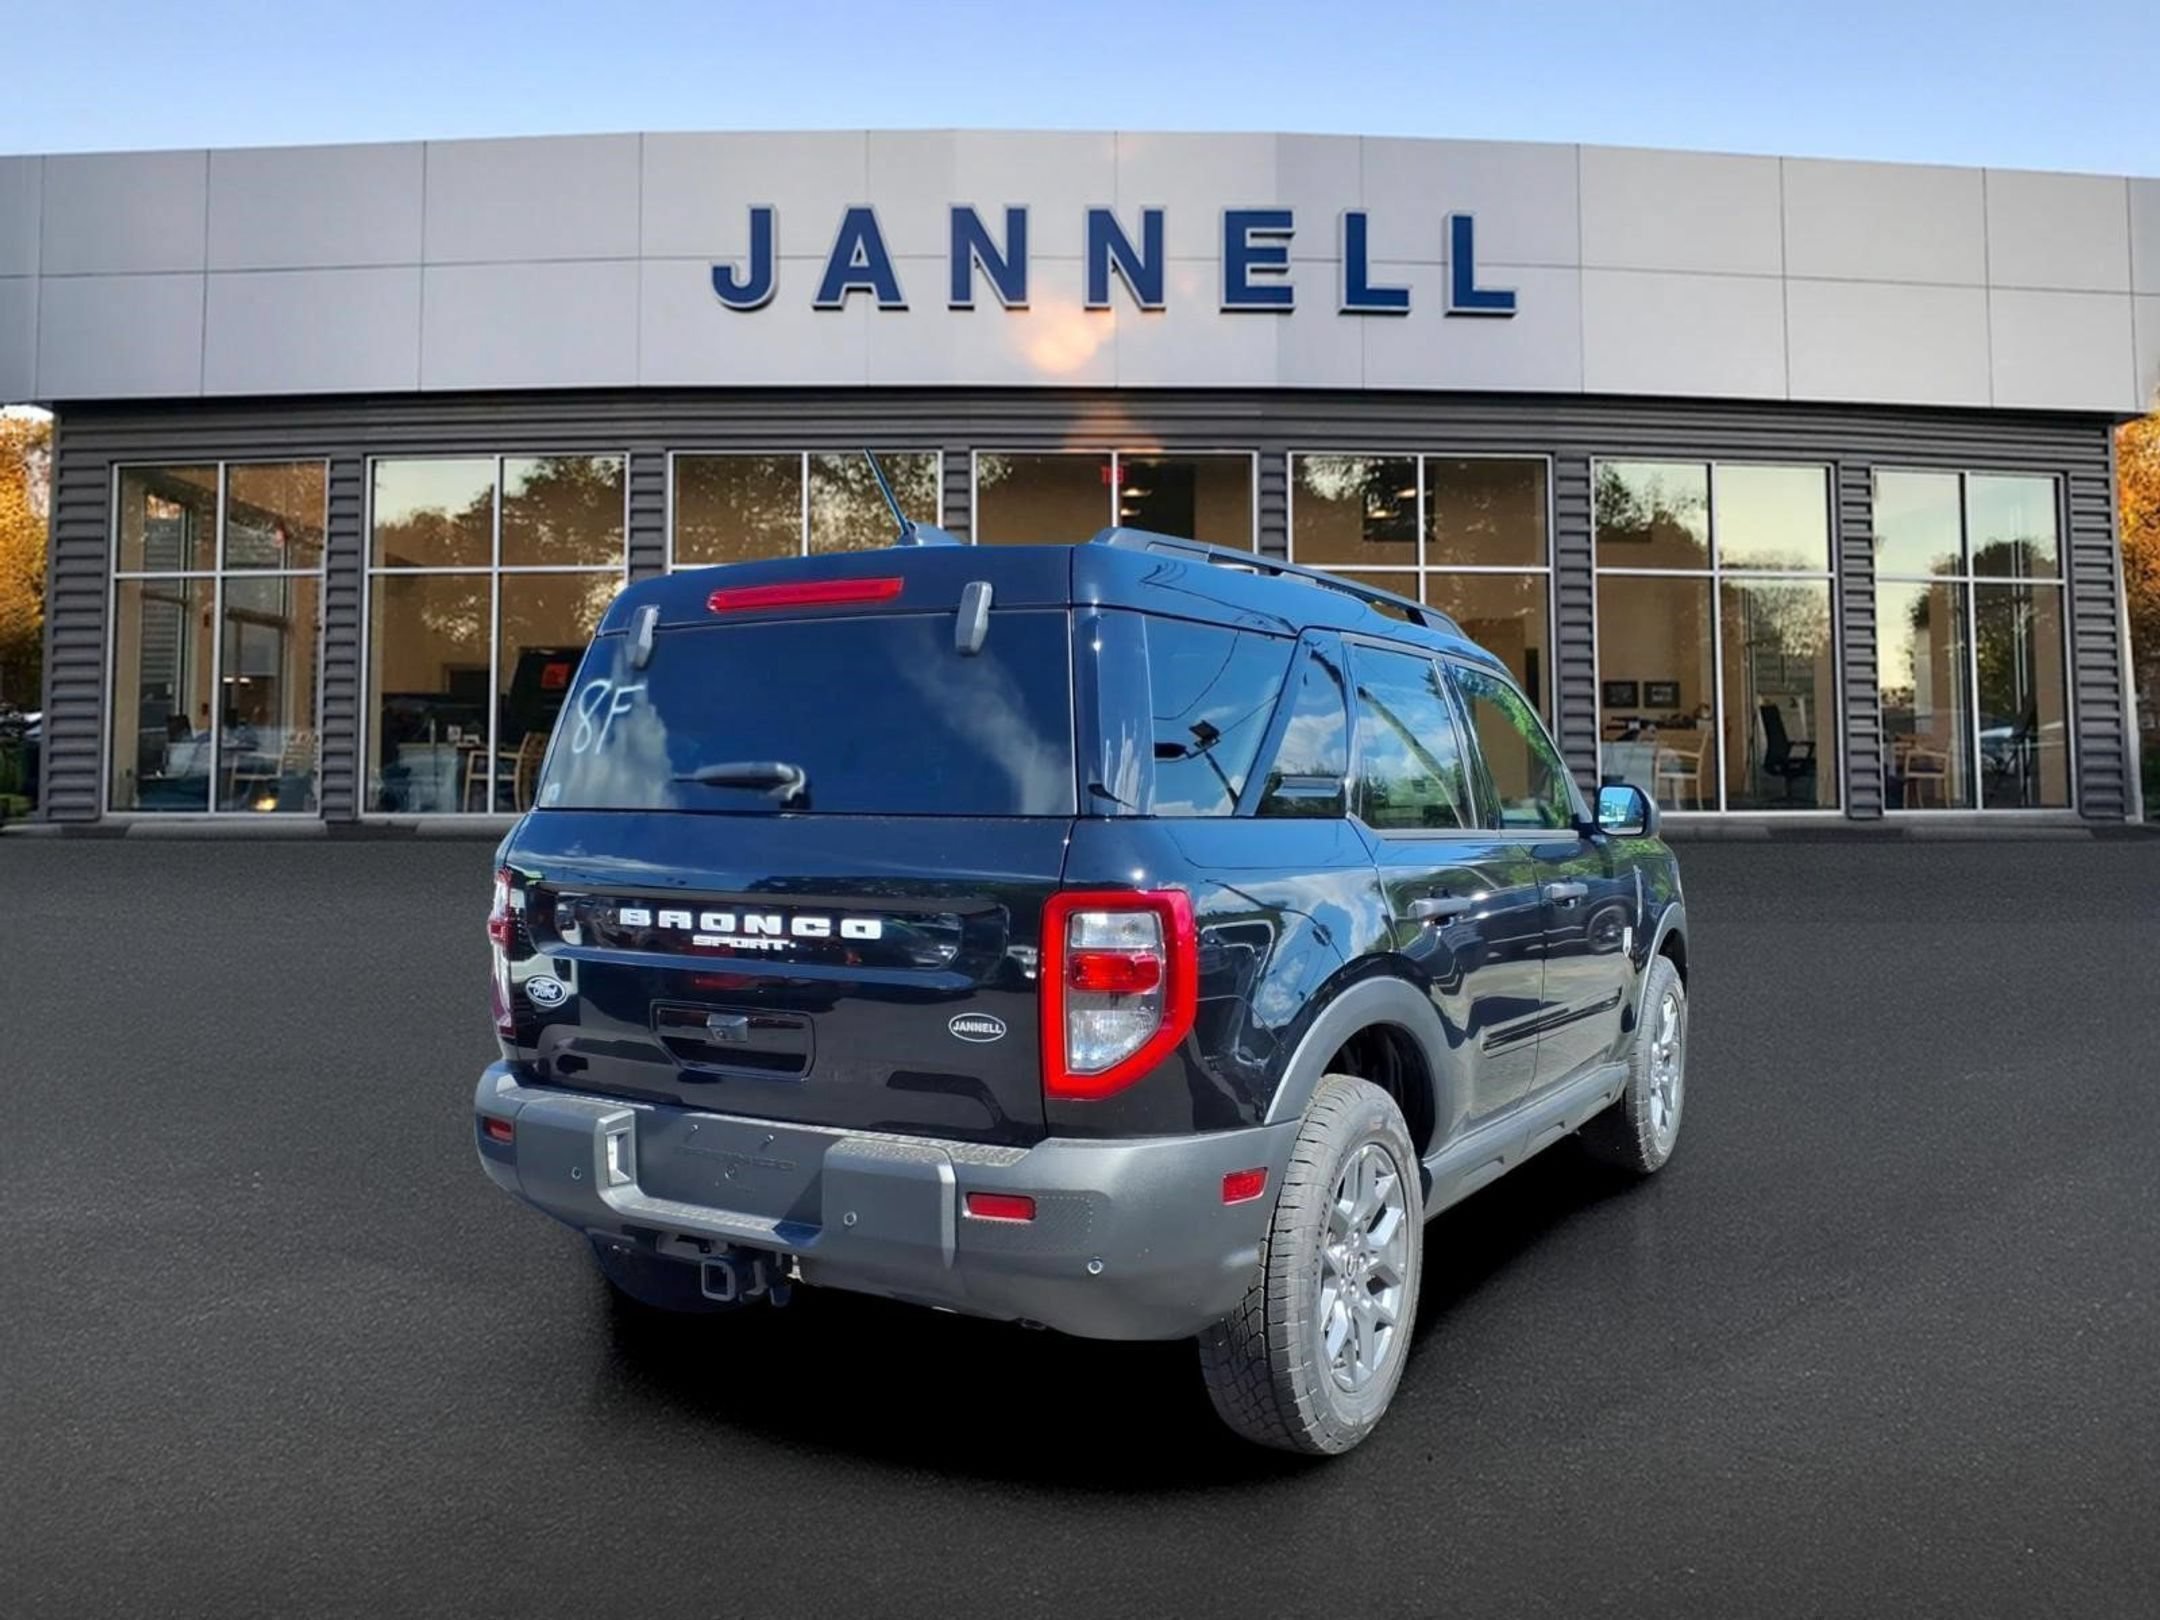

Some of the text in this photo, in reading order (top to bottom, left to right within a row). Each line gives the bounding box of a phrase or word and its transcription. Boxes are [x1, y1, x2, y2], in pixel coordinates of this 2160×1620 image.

[711, 204, 1518, 317] JANNELL
[619, 907, 882, 940] BRONCO
[692, 934, 791, 951] SPORT
[952, 1020, 1003, 1034] JANNELL
